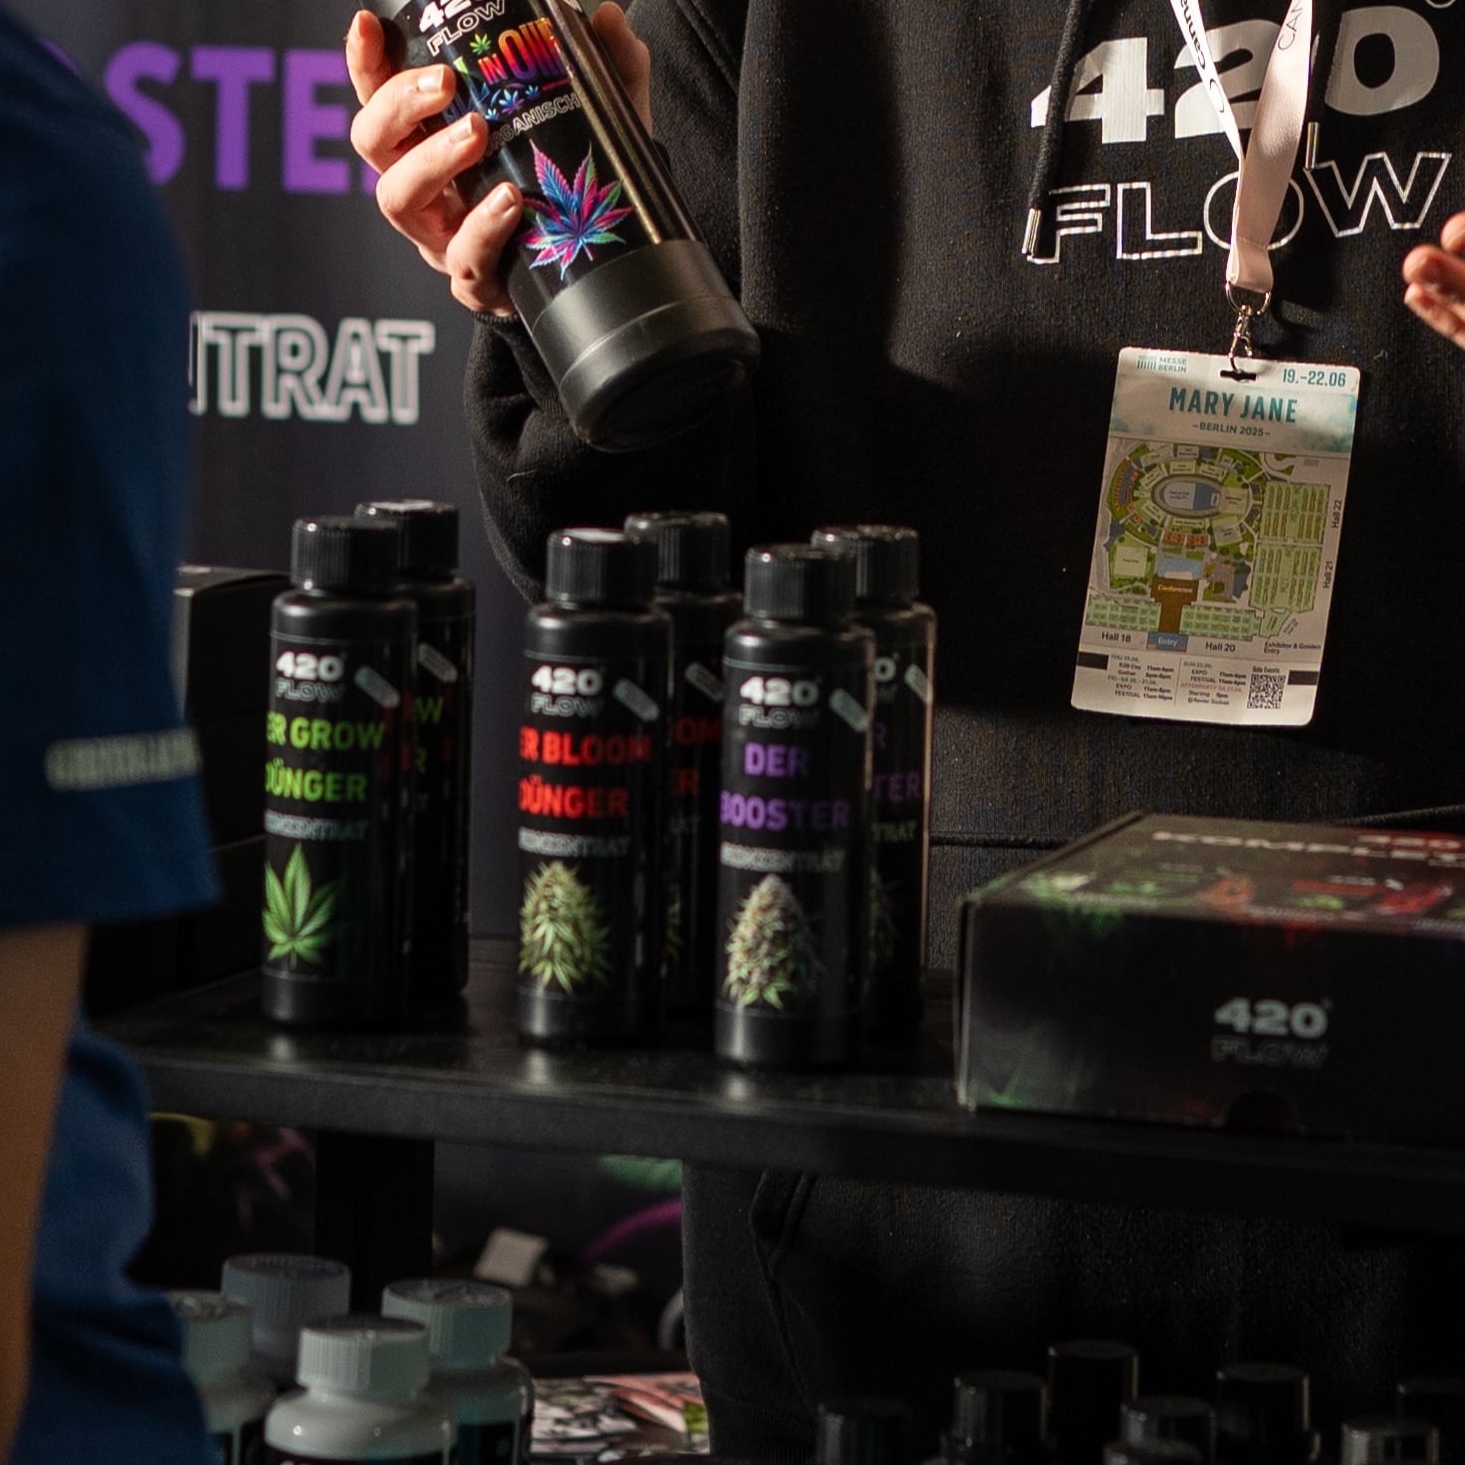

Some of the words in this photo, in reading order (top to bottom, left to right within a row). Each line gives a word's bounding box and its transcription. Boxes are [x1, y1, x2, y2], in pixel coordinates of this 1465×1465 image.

[477, 53, 509, 85] IN
[1030, 5, 1441, 144] 420
[485, 91, 582, 157] RGANISCH
[1026, 150, 1453, 265] FLOW
[1157, 364, 1187, 374] BERLIN
[1158, 356, 1187, 366] MESSE
[1282, 368, 1347, 388] 19.-22.06
[1168, 386, 1235, 418] MARY
[1239, 394, 1299, 423] JANE
[1101, 631, 1119, 641] Hall
[1205, 642, 1223, 651] Hall
[1224, 643, 1236, 652] 20
[275, 650, 345, 682] 420
[530, 664, 604, 696] 420
[275, 677, 345, 703] FLOW
[739, 675, 820, 707] 420
[289, 715, 385, 751] GROW
[541, 729, 653, 766] BLOOM
[743, 741, 811, 778] DER
[1214, 996, 1329, 1040] 420
